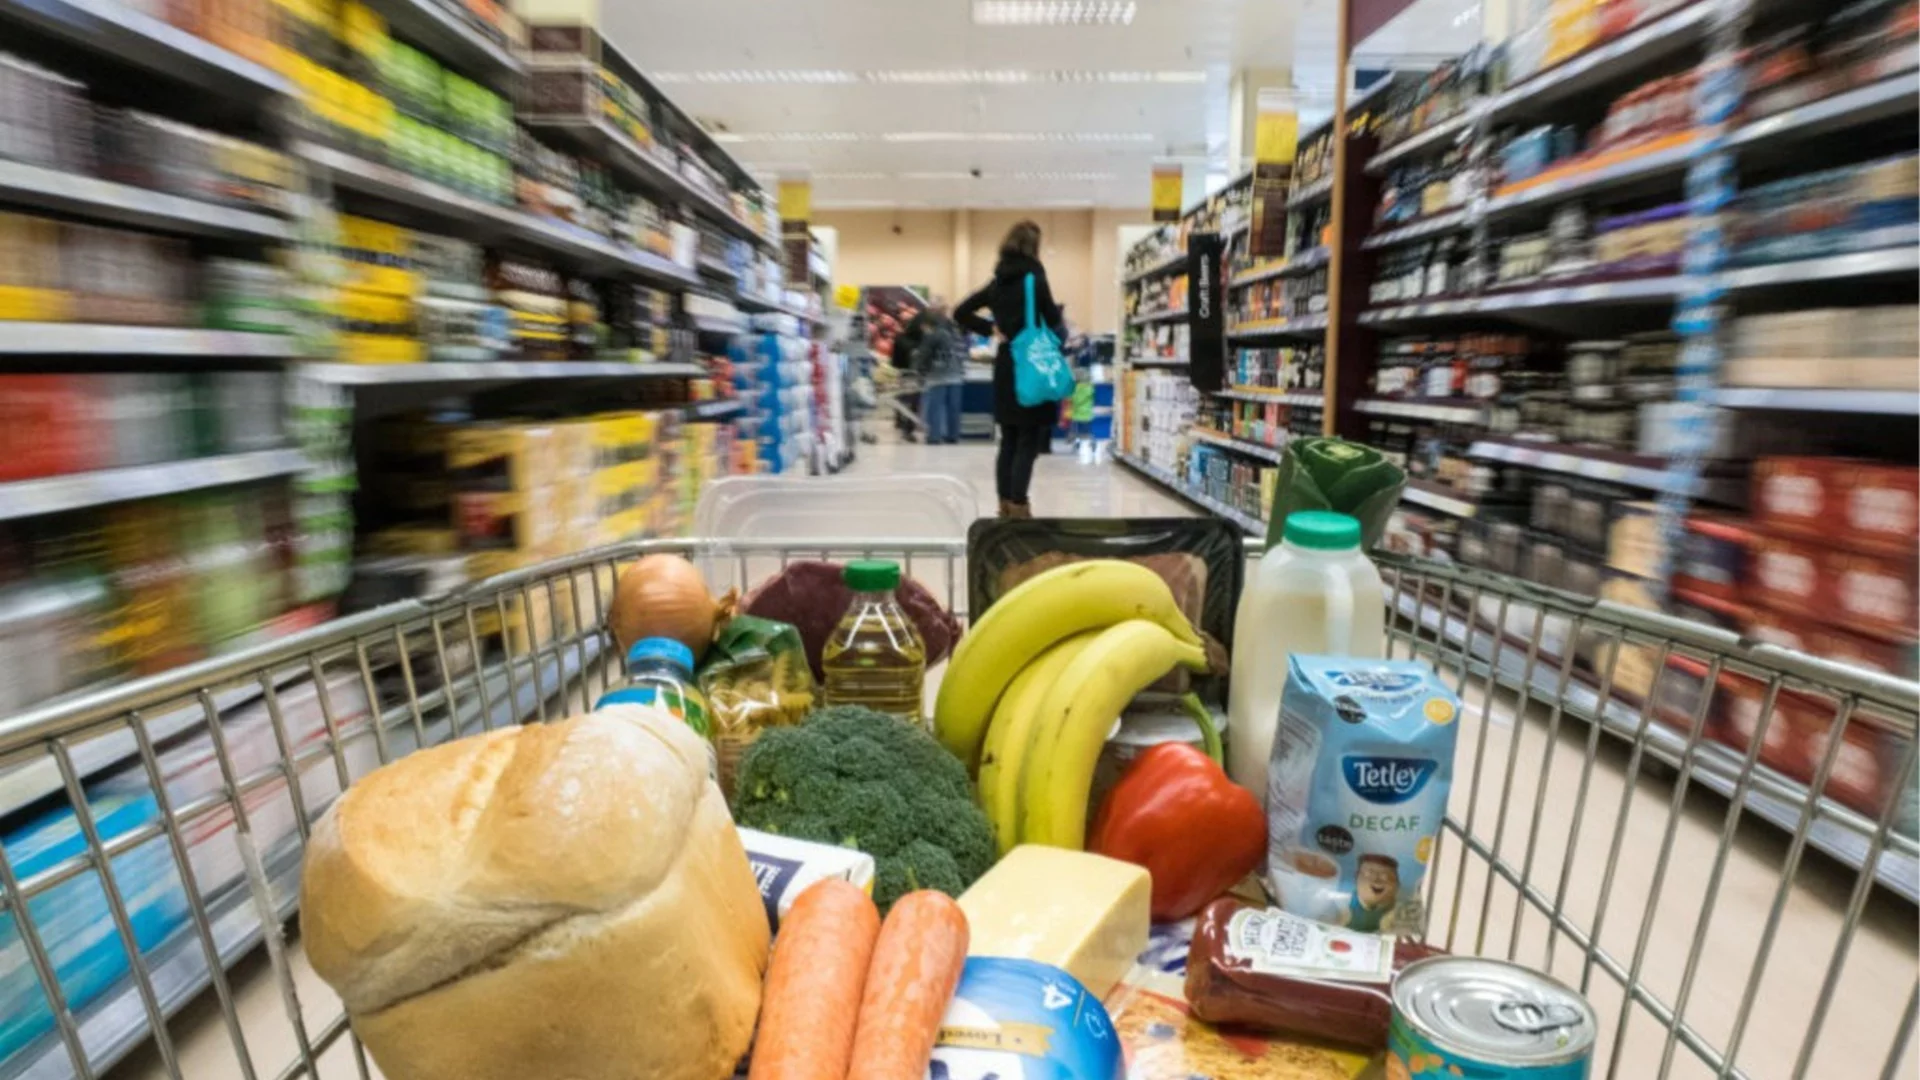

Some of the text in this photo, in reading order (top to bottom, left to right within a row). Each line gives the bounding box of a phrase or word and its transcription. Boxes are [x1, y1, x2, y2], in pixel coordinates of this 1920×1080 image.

[1199, 289, 1210, 319] Craft
[1353, 761, 1424, 794] Tetley
[1349, 813, 1421, 831] DECAF
[1243, 915, 1268, 948] HEINZ
[1270, 917, 1291, 957] TOMATO
